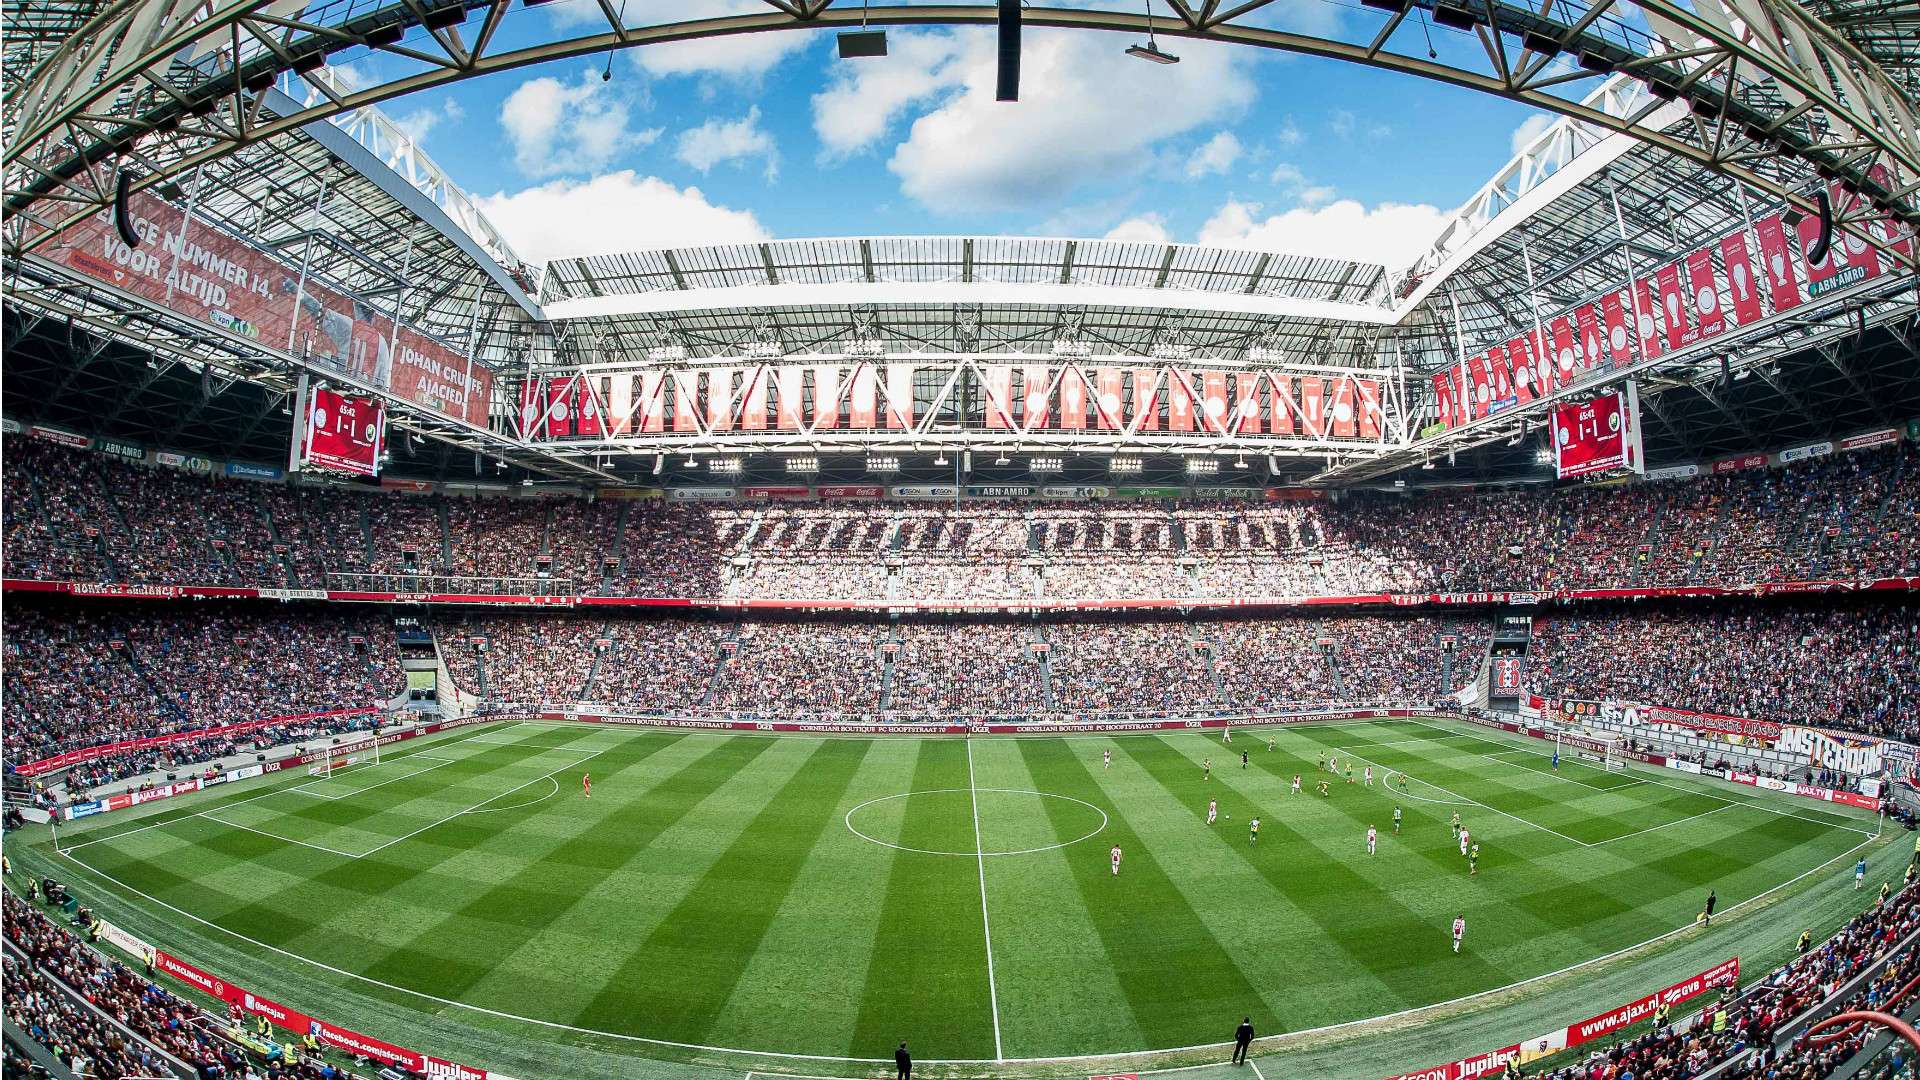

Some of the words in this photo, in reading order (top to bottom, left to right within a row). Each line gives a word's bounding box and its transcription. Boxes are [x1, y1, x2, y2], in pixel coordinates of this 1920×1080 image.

[104, 234, 160, 280] VOOR
[163, 230, 250, 288] NUMMER
[400, 346, 440, 376] JOHAN
[1774, 726, 1882, 776] AMSTERDAM
[1734, 772, 1756, 783] Jupiler
[138, 788, 167, 801] AJAX.NL
[174, 782, 196, 794] Jupiler
[1796, 785, 1826, 797] AJAX.TV
[1704, 965, 1726, 980] supporter
[1682, 980, 1700, 996] GVB
[254, 1001, 286, 1020] @afcajax
[1581, 994, 1659, 1037] www.ajax.nl
[322, 1028, 414, 1066] facebook.com/afcajax
